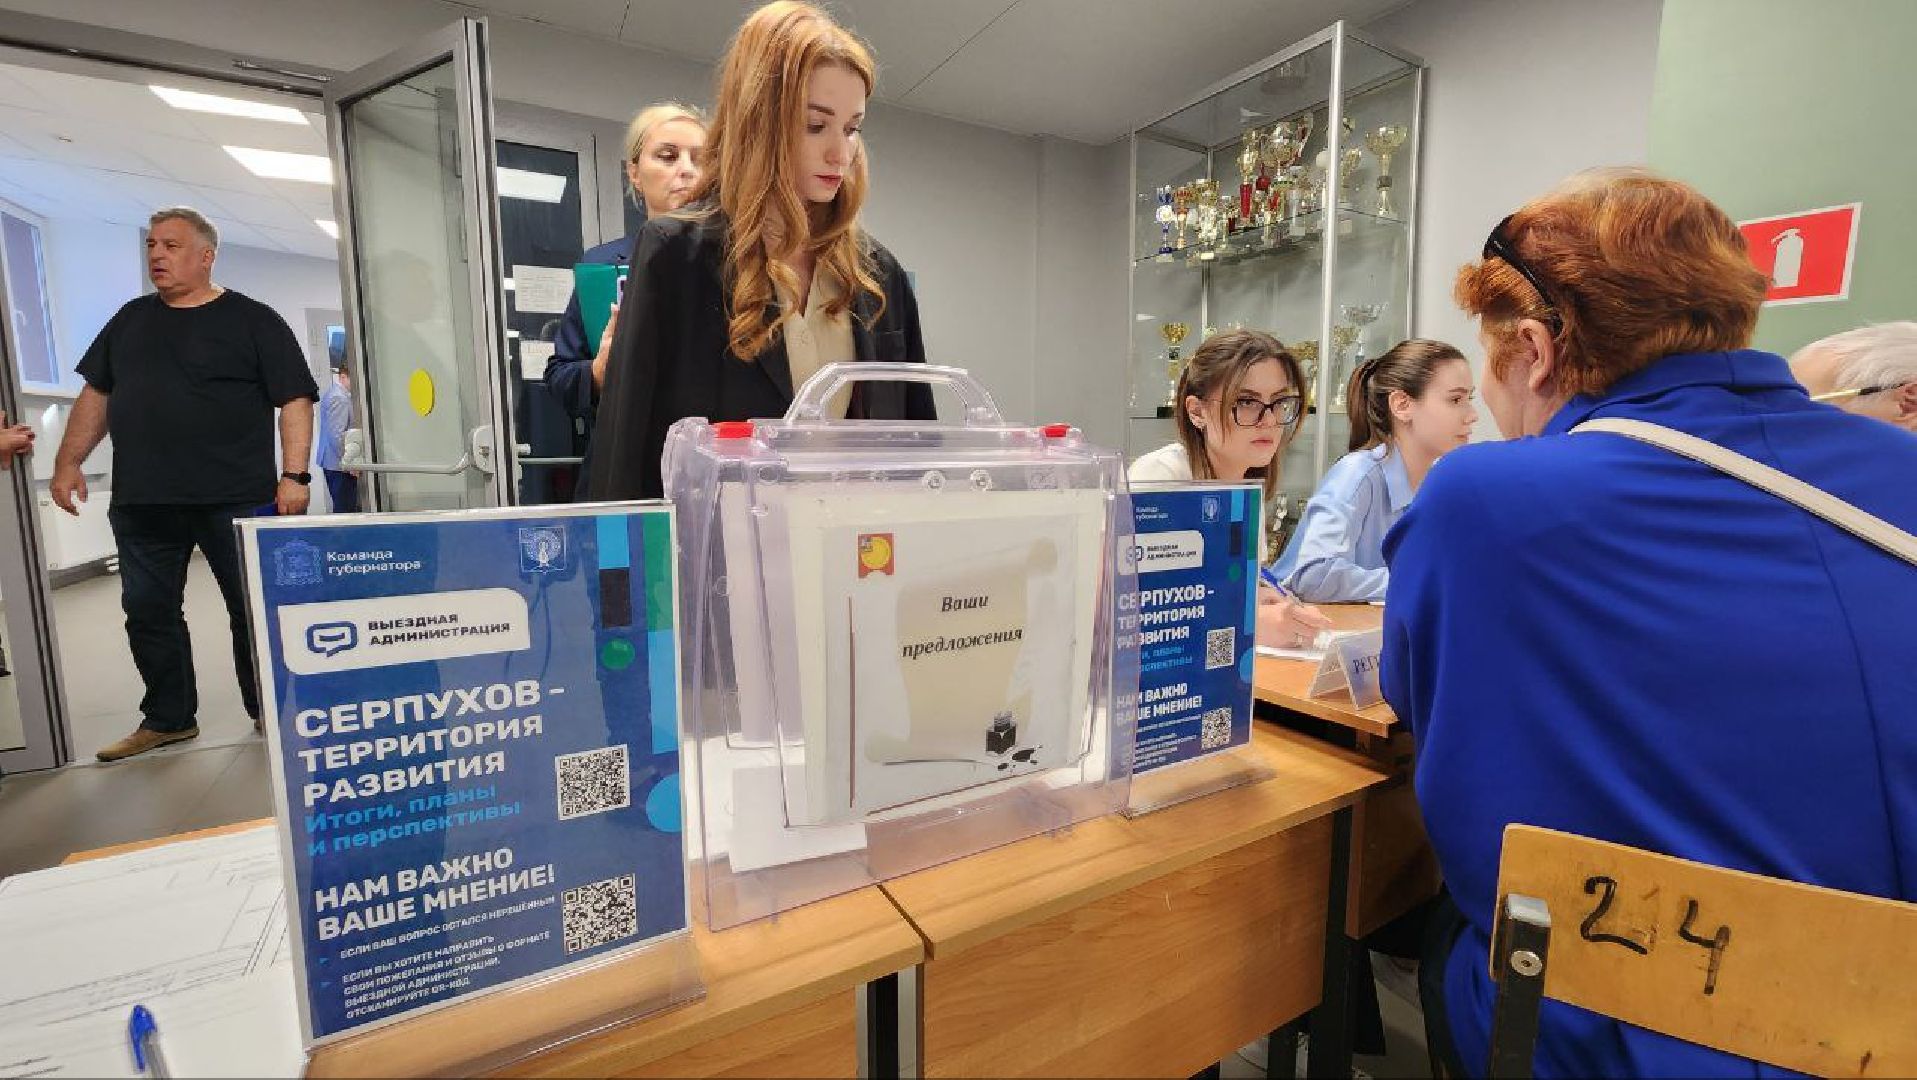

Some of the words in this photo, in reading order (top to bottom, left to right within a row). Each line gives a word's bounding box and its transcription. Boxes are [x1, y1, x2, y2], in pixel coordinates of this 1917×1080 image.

[327, 550, 393, 562] Команда
[328, 560, 422, 576] губернатора
[368, 613, 458, 631] ВЫЕЗДНАЯ
[942, 595, 989, 612] Ваши
[370, 622, 510, 646] АДМИНИСТРАЦИЯ
[902, 628, 1023, 660] предложения
[295, 680, 541, 738] СЕРПУХОВ
[1145, 682, 1188, 702] ВАЖНО
[1153, 695, 1203, 717] МНЕНИЕ!
[298, 714, 543, 772] ТЕРРИТОРИЯ
[303, 751, 505, 807] РАЗВИТИЯ
[304, 802, 402, 834] Итоги,
[409, 784, 496, 814] планы
[307, 840, 326, 857] и
[334, 801, 521, 851] перспективы
[315, 875, 390, 913] НАМ
[397, 847, 513, 893] ВАЖНО
[318, 897, 417, 941] ВАШЕ
[423, 863, 556, 914] МНЕНИЕ!
[340, 944, 371, 959] ЕСЛИ
[372, 936, 397, 950] ВАШ
[399, 926, 440, 943] ВОПРОС
[442, 912, 487, 931] ОСТАЛСЯ
[342, 968, 373, 983] ЕСЛИ
[374, 963, 393, 975] ВЫ
[394, 950, 433, 969] ХОТИТЕ
[434, 935, 495, 958] НАПРАВИТЬ
[344, 981, 375, 996] СВОИ
[376, 960, 443, 983] ПОЖЕЛАНИЯ
[506, 930, 550, 949] ФОРМАТЕ
[345, 982, 406, 1009] ВЫЕЗДНОЙ
[346, 986, 429, 1019] ОТСКАНИРУЙТЕ
